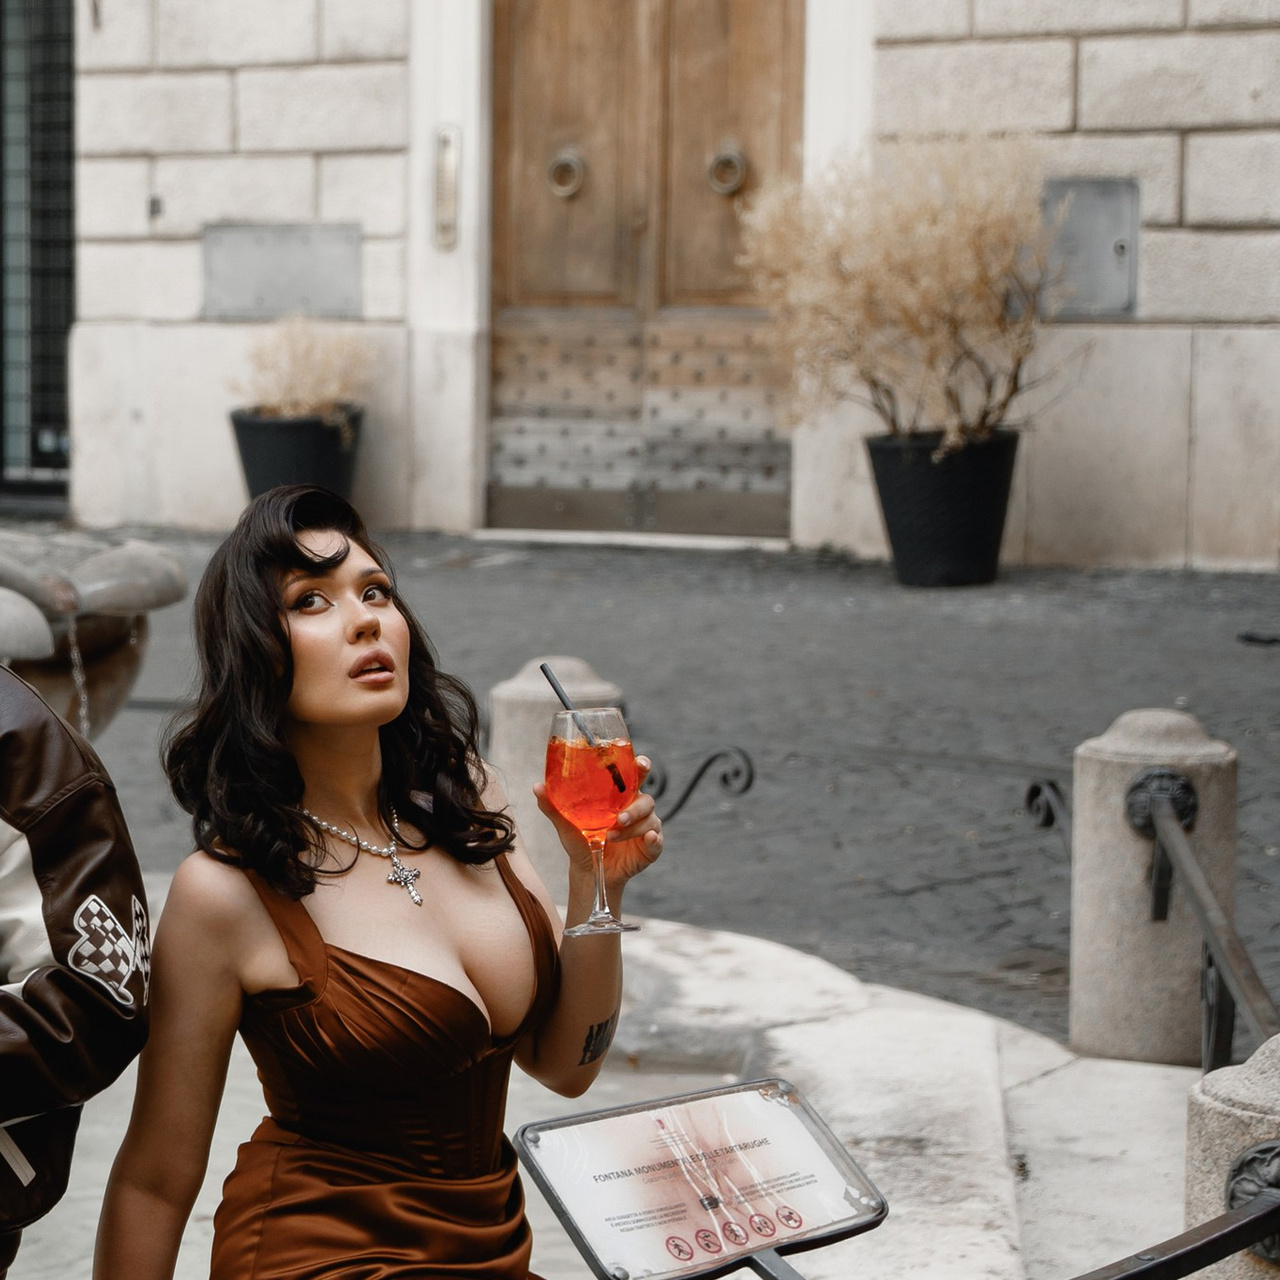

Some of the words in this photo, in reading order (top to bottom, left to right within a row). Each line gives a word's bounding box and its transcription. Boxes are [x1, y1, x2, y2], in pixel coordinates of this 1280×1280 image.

[593, 1168, 634, 1183] FONTANA
[634, 1153, 696, 1175] MONUMENTALE
[696, 1148, 720, 1163] DELLE
[720, 1137, 772, 1156] TARTARUGHE
